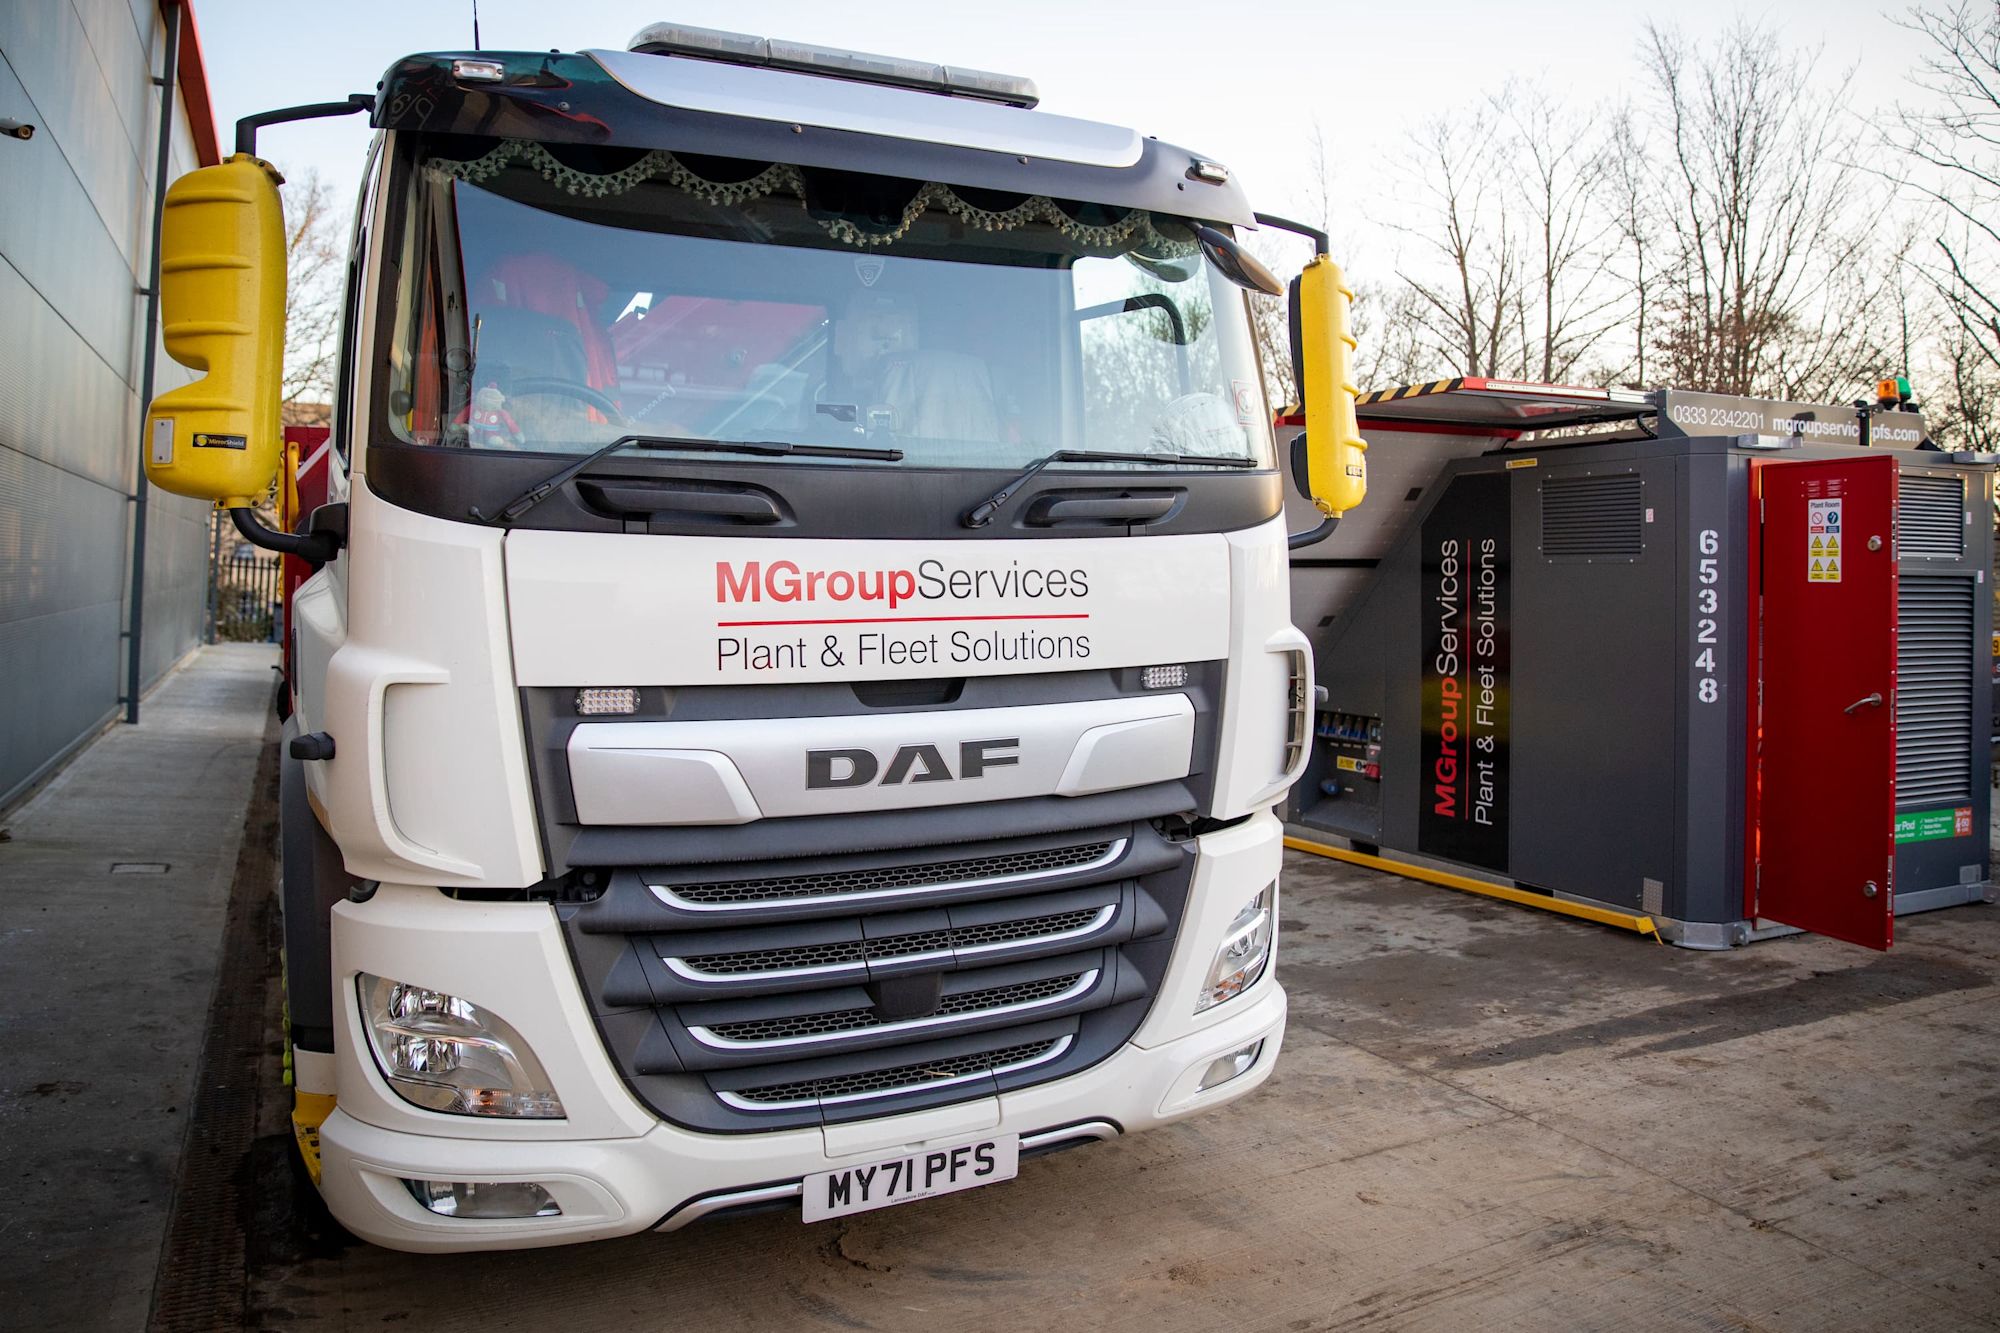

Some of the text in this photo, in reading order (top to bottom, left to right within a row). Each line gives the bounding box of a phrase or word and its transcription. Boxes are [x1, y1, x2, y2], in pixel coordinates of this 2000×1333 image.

[208, 438, 244, 446] MirrorShield
[1673, 404, 1920, 442] 0333 2342201 mgroupservicpfs.com
[716, 559, 1090, 610] MGroupServices
[717, 630, 1091, 671] Plant & Fleet Solutions
[1434, 538, 1463, 818] MGroupServices
[1474, 537, 1496, 826] Plant & Fleet Solutions
[805, 736, 1020, 790] DAF
[828, 1142, 996, 1209] MY71 PFS
